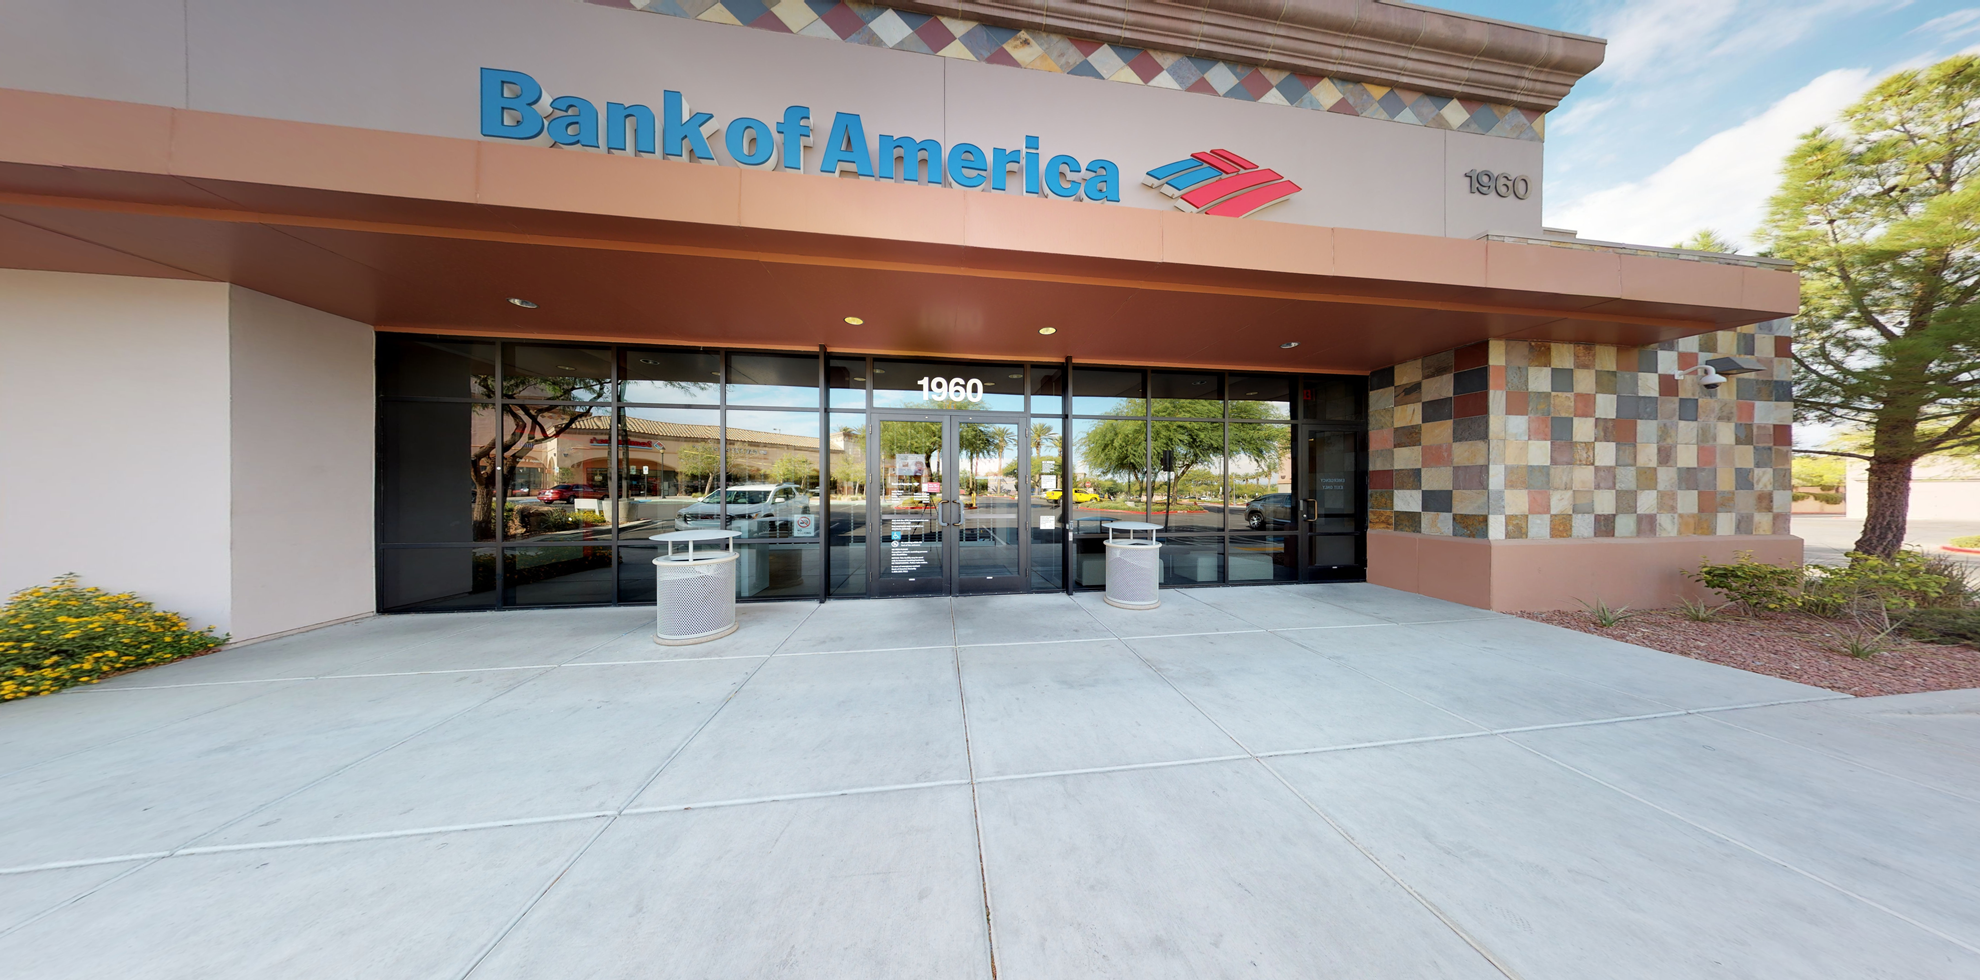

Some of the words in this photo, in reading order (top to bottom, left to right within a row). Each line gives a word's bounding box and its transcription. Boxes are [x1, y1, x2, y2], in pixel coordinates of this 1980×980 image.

[480, 67, 717, 163] Bank
[725, 105, 812, 172] of
[820, 111, 1121, 203] America
[1465, 168, 1532, 200] 1960
[917, 376, 984, 402] 1960
